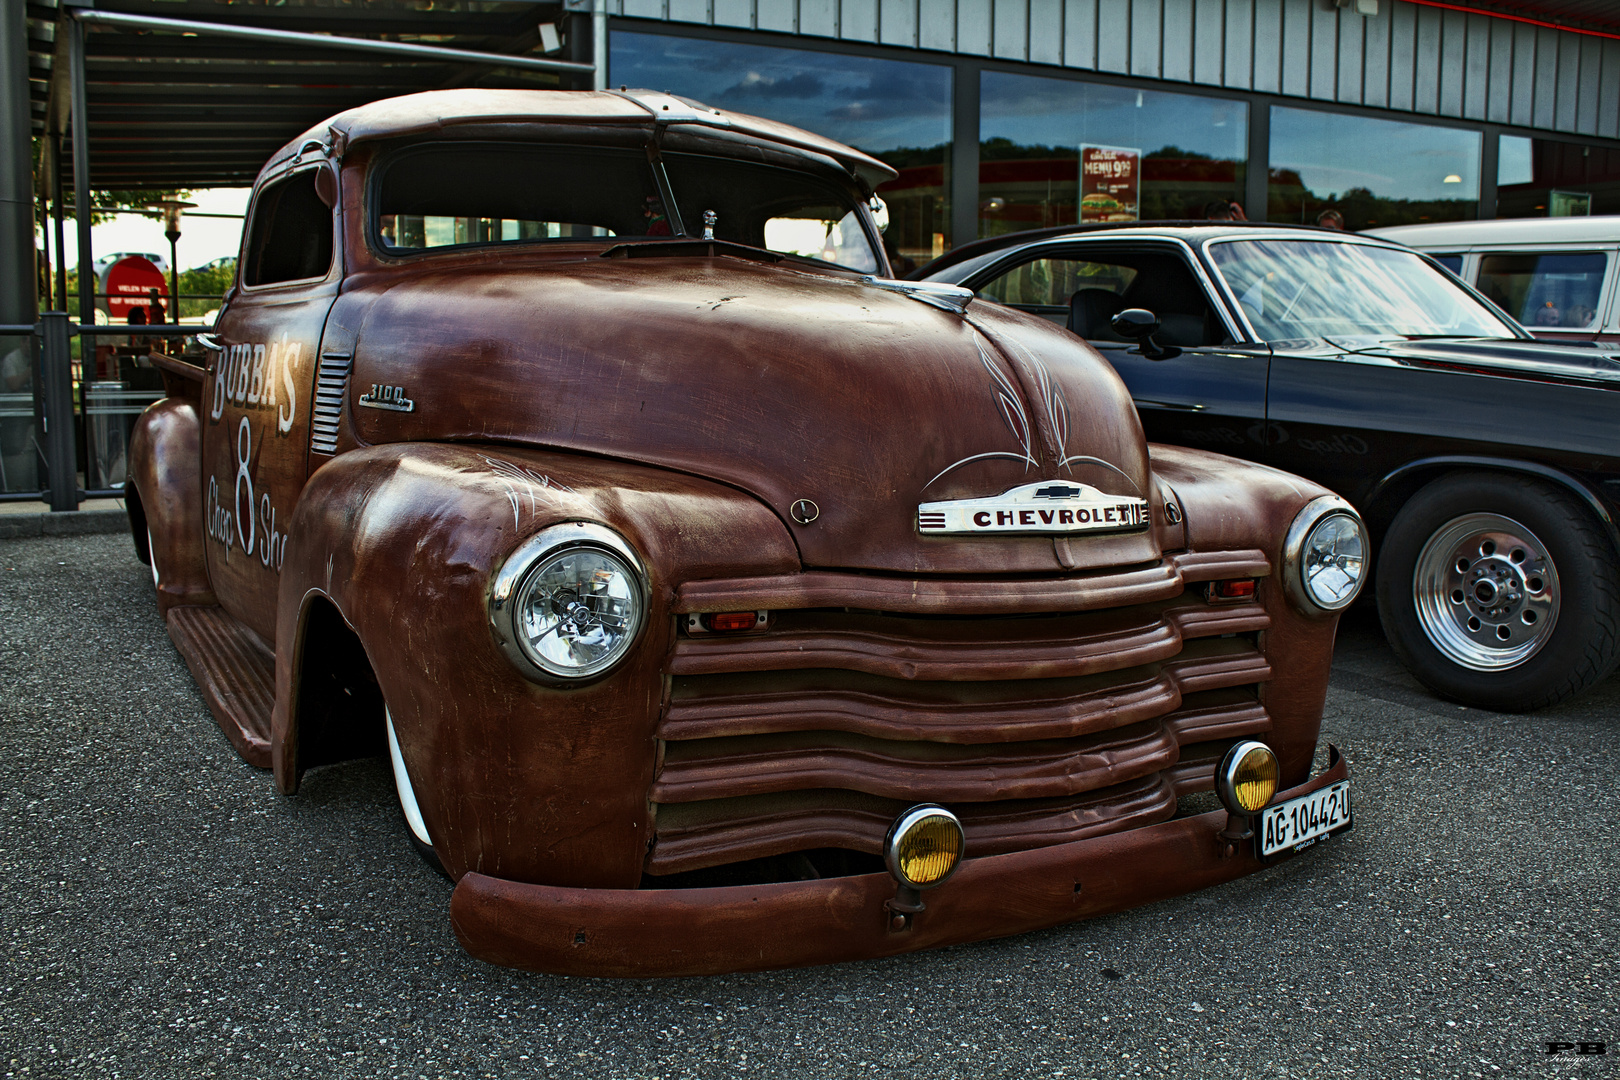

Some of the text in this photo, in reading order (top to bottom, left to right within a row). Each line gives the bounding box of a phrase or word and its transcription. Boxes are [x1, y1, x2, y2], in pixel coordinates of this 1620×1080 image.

[109, 297, 122, 305] AUF
[211, 332, 301, 432] BUBBA'S
[370, 384, 403, 401] 3100
[207, 474, 234, 561] Chop
[973, 504, 1130, 527] CHEVROLET
